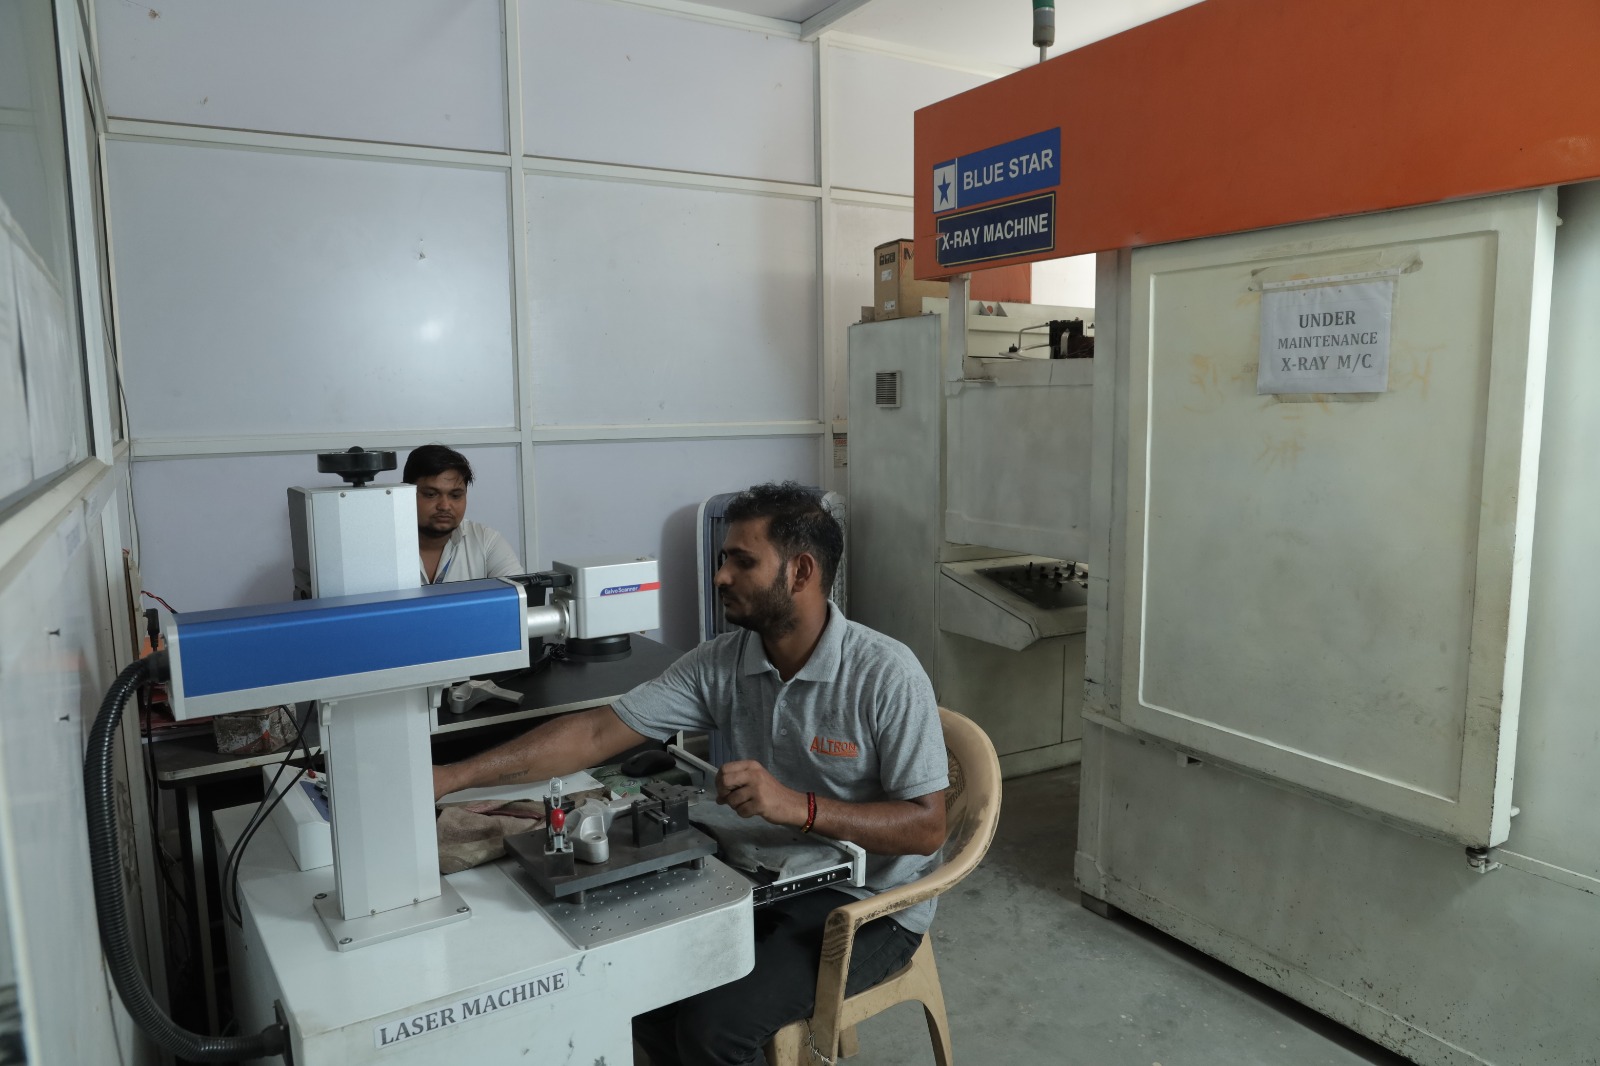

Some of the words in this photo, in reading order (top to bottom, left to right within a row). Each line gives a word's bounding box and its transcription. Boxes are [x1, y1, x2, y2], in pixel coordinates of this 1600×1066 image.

[963, 162, 1004, 191] BLUE
[1008, 148, 1054, 179] STAR
[941, 227, 980, 251] X-RAY
[983, 213, 1049, 243] MACHINE
[1299, 310, 1356, 328] UNDER
[1278, 332, 1378, 350] MAINTENANCE
[1281, 355, 1330, 372] X-RAY
[1337, 353, 1372, 373] M/C
[809, 736, 857, 753] ALTRON
[379, 1007, 456, 1046] LASER
[461, 972, 565, 1020] MACHINE
